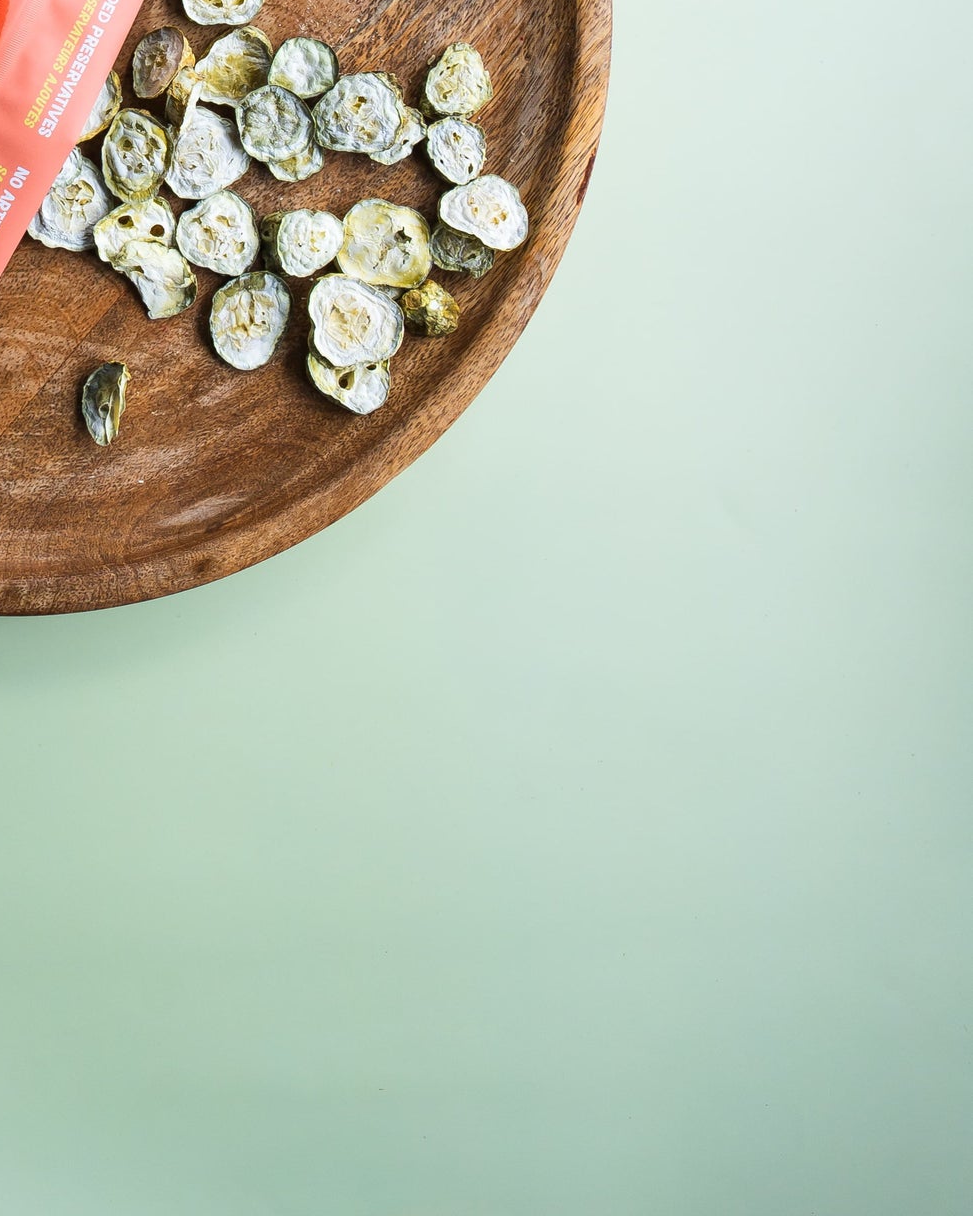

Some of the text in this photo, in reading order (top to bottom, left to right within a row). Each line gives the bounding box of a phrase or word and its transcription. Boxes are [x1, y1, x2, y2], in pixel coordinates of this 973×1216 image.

[23, 72, 58, 129] AJOUTÉS
[38, 24, 104, 138] PRESERVATIVES
[9, 165, 30, 189] NO
